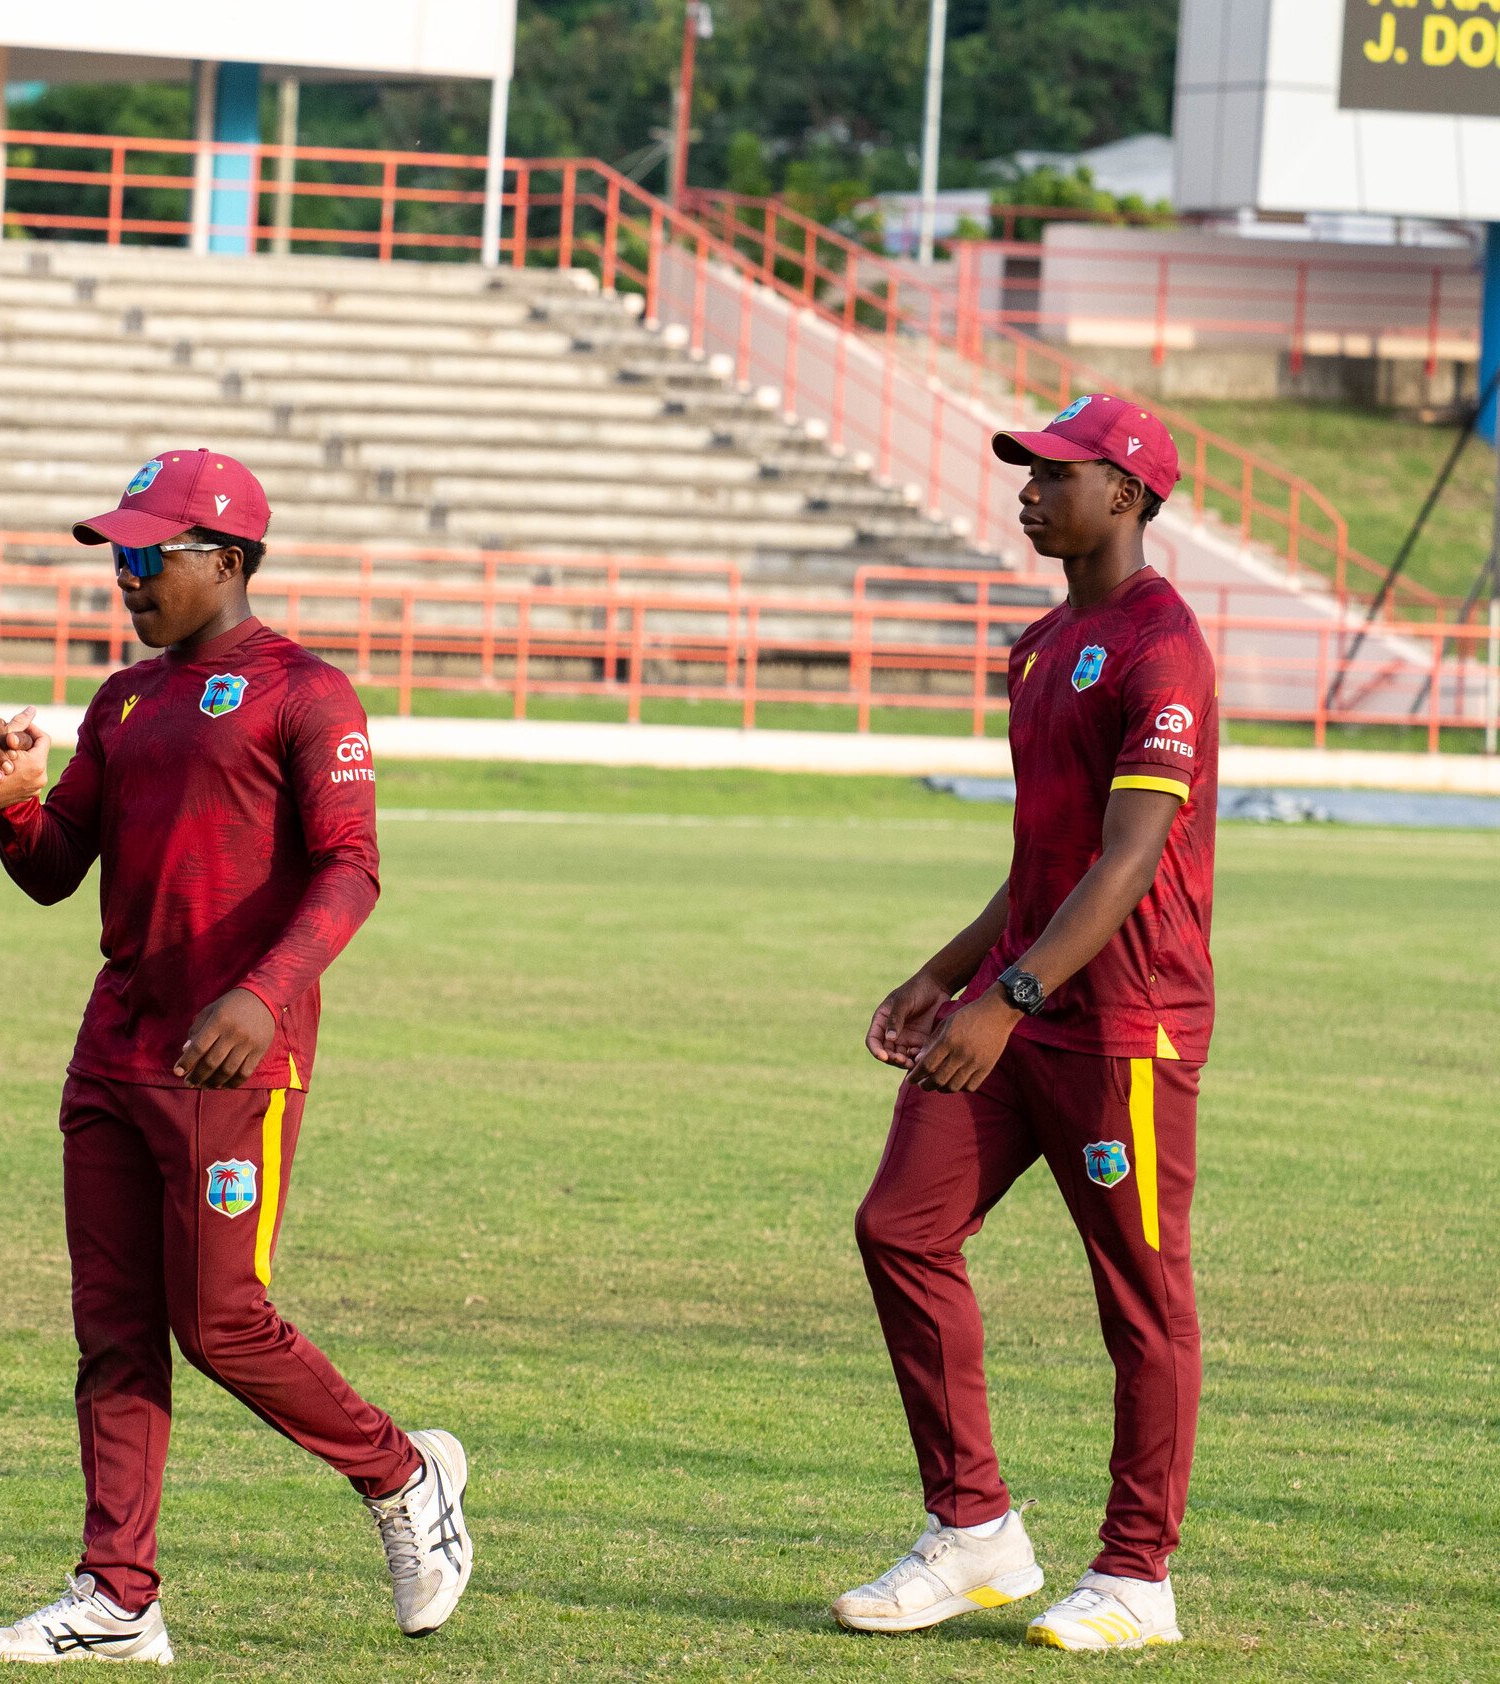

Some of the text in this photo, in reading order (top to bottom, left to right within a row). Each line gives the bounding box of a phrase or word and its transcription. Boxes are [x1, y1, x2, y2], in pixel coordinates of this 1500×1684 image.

[1363, 11, 1500, 69] J. DO
[1155, 712, 1184, 734] CG
[336, 742, 365, 763] CG
[1143, 736, 1194, 758] UNITED
[330, 768, 376, 784] UNITE
